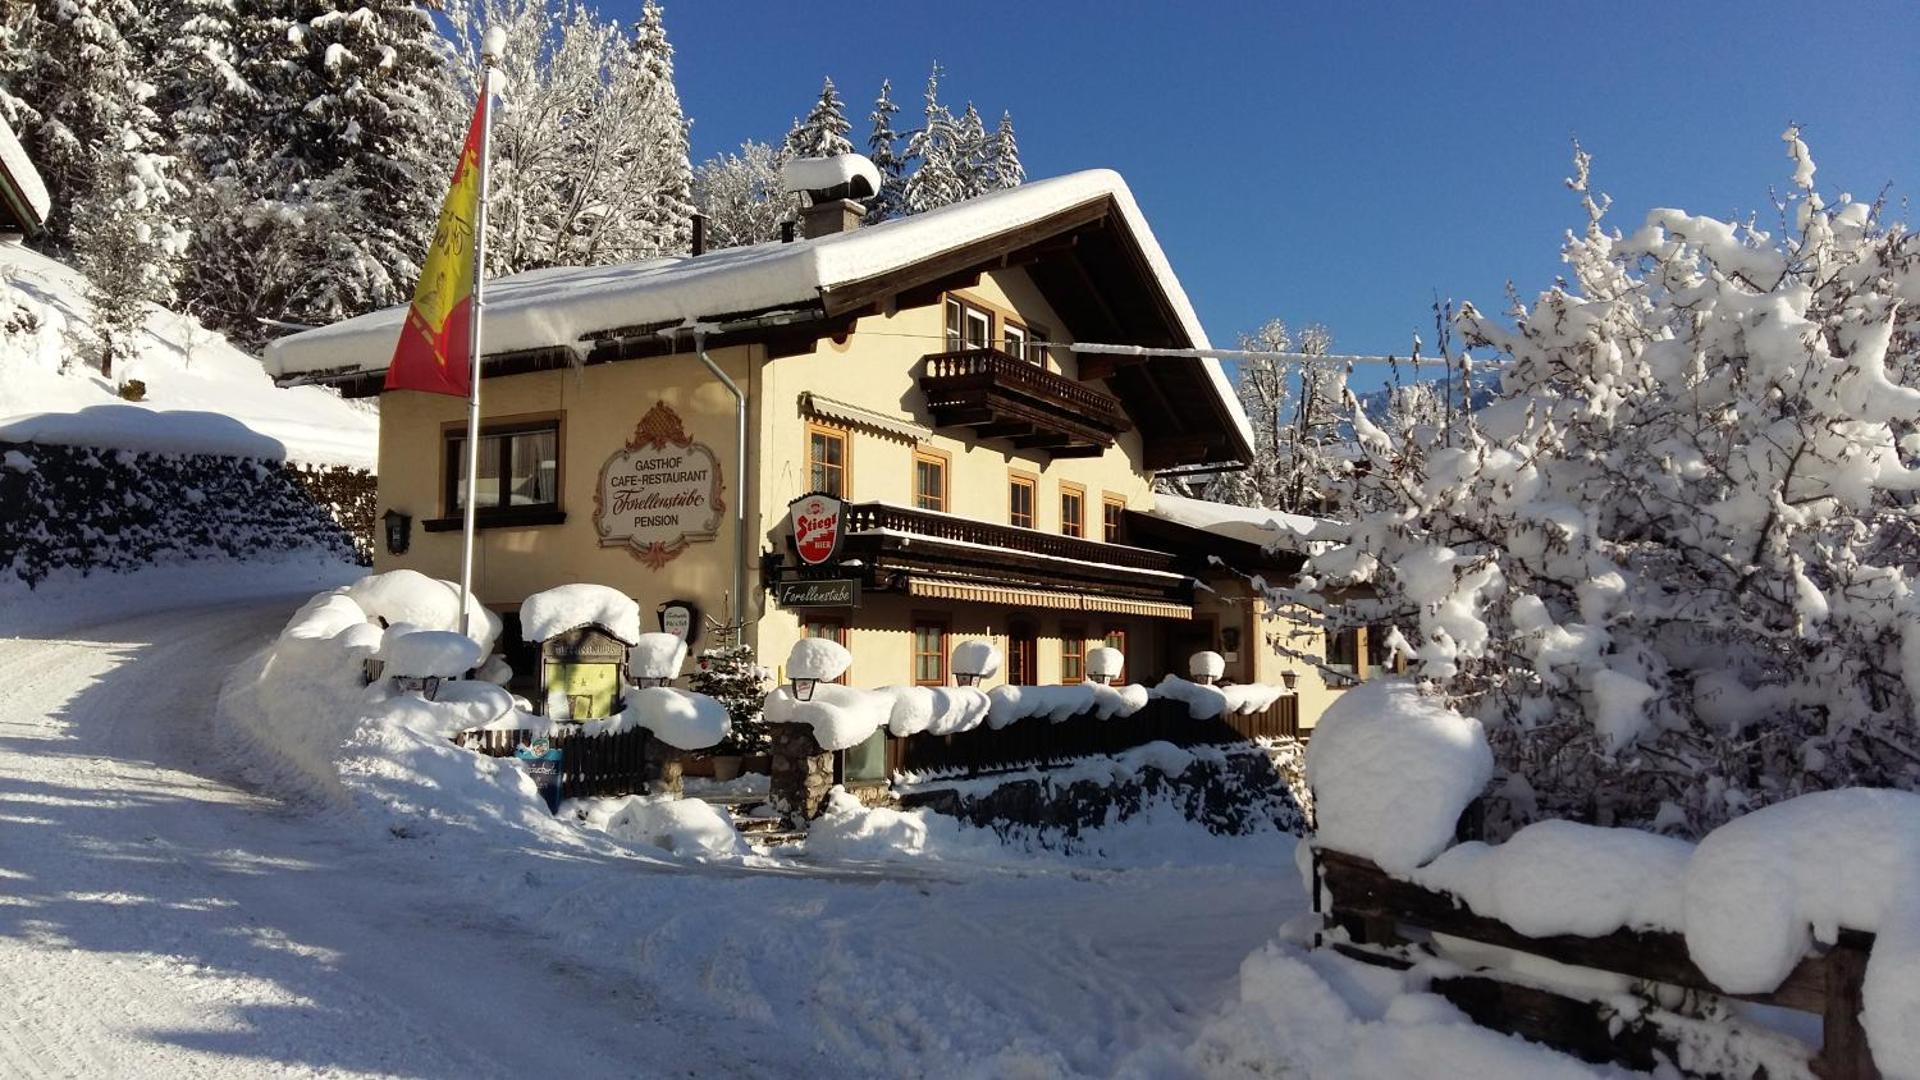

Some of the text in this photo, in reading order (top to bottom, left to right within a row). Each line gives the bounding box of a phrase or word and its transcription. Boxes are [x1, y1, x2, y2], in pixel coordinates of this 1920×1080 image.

[635, 457, 682, 471] GASTHOF
[611, 470, 708, 487] CAFE-RESTAURANT
[634, 514, 679, 528] PENSION
[797, 513, 837, 542] Stiegl
